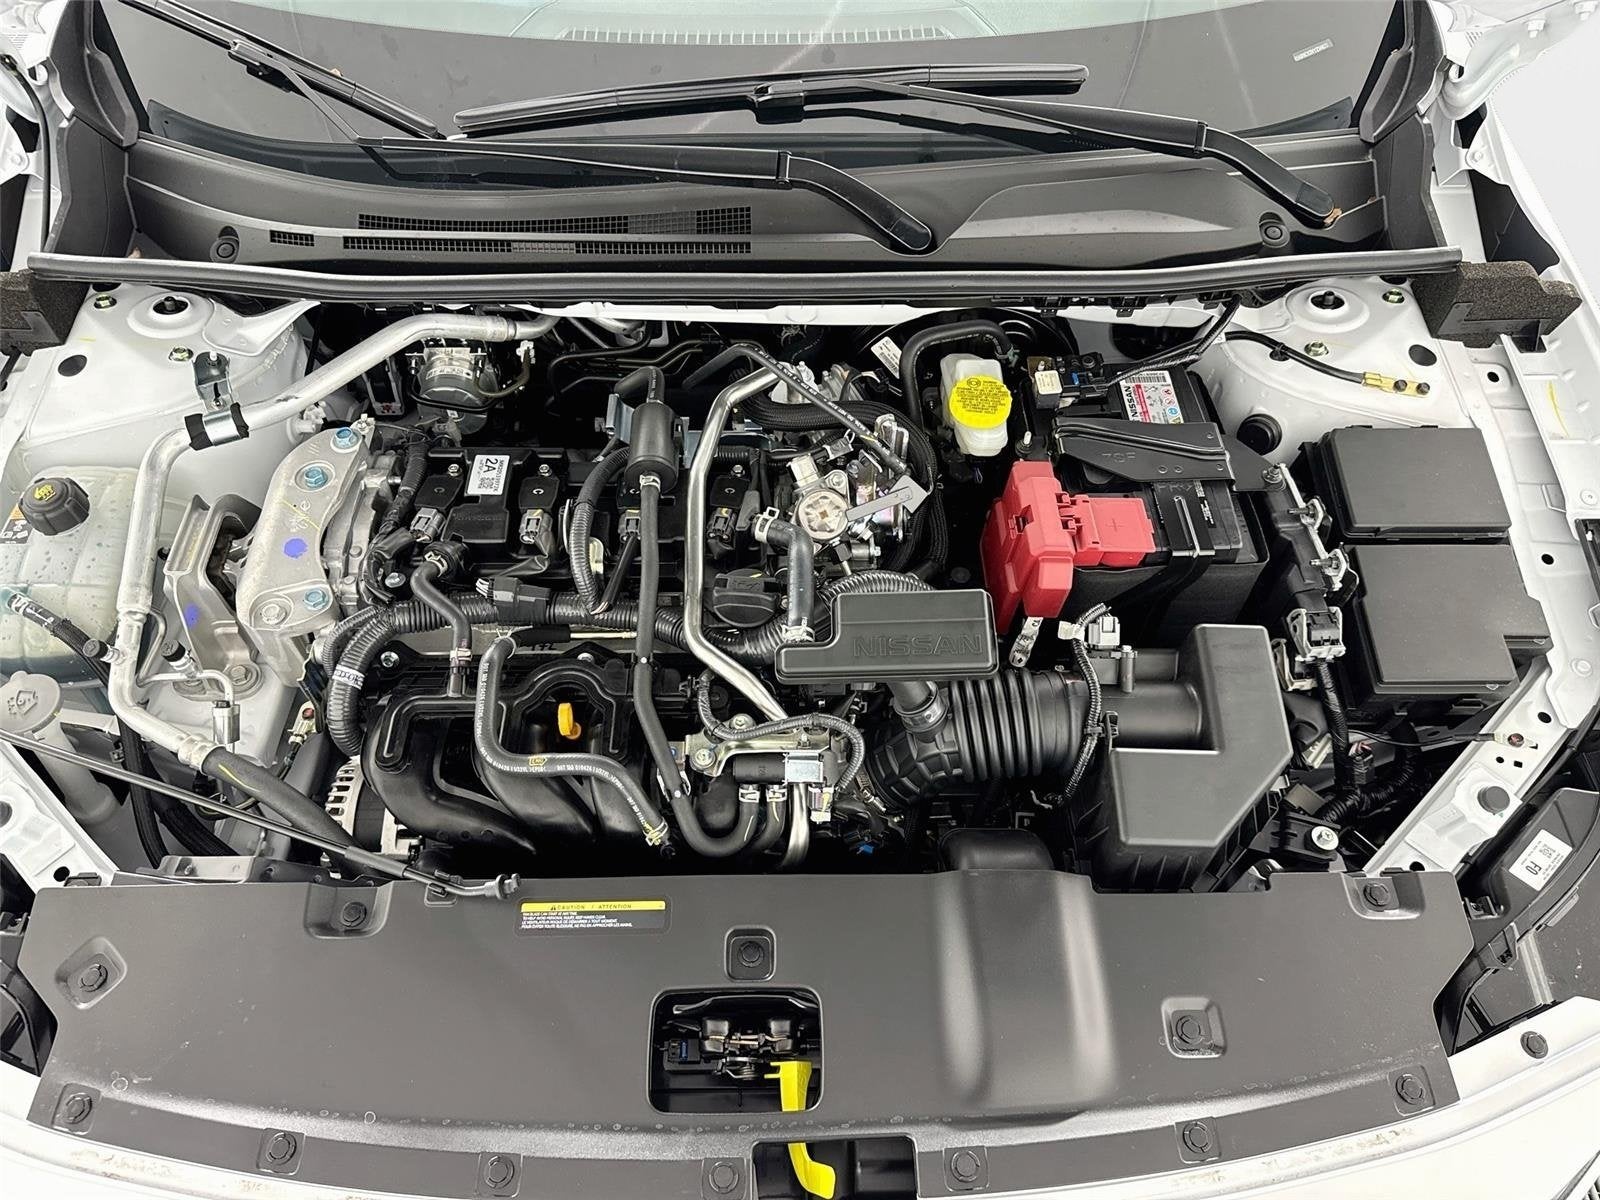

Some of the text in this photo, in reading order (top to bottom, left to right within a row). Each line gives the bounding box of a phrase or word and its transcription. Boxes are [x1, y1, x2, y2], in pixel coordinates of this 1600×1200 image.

[1123, 385, 1139, 418] NISSAN
[483, 458, 498, 473] 2A
[853, 633, 984, 657] NISSAN
